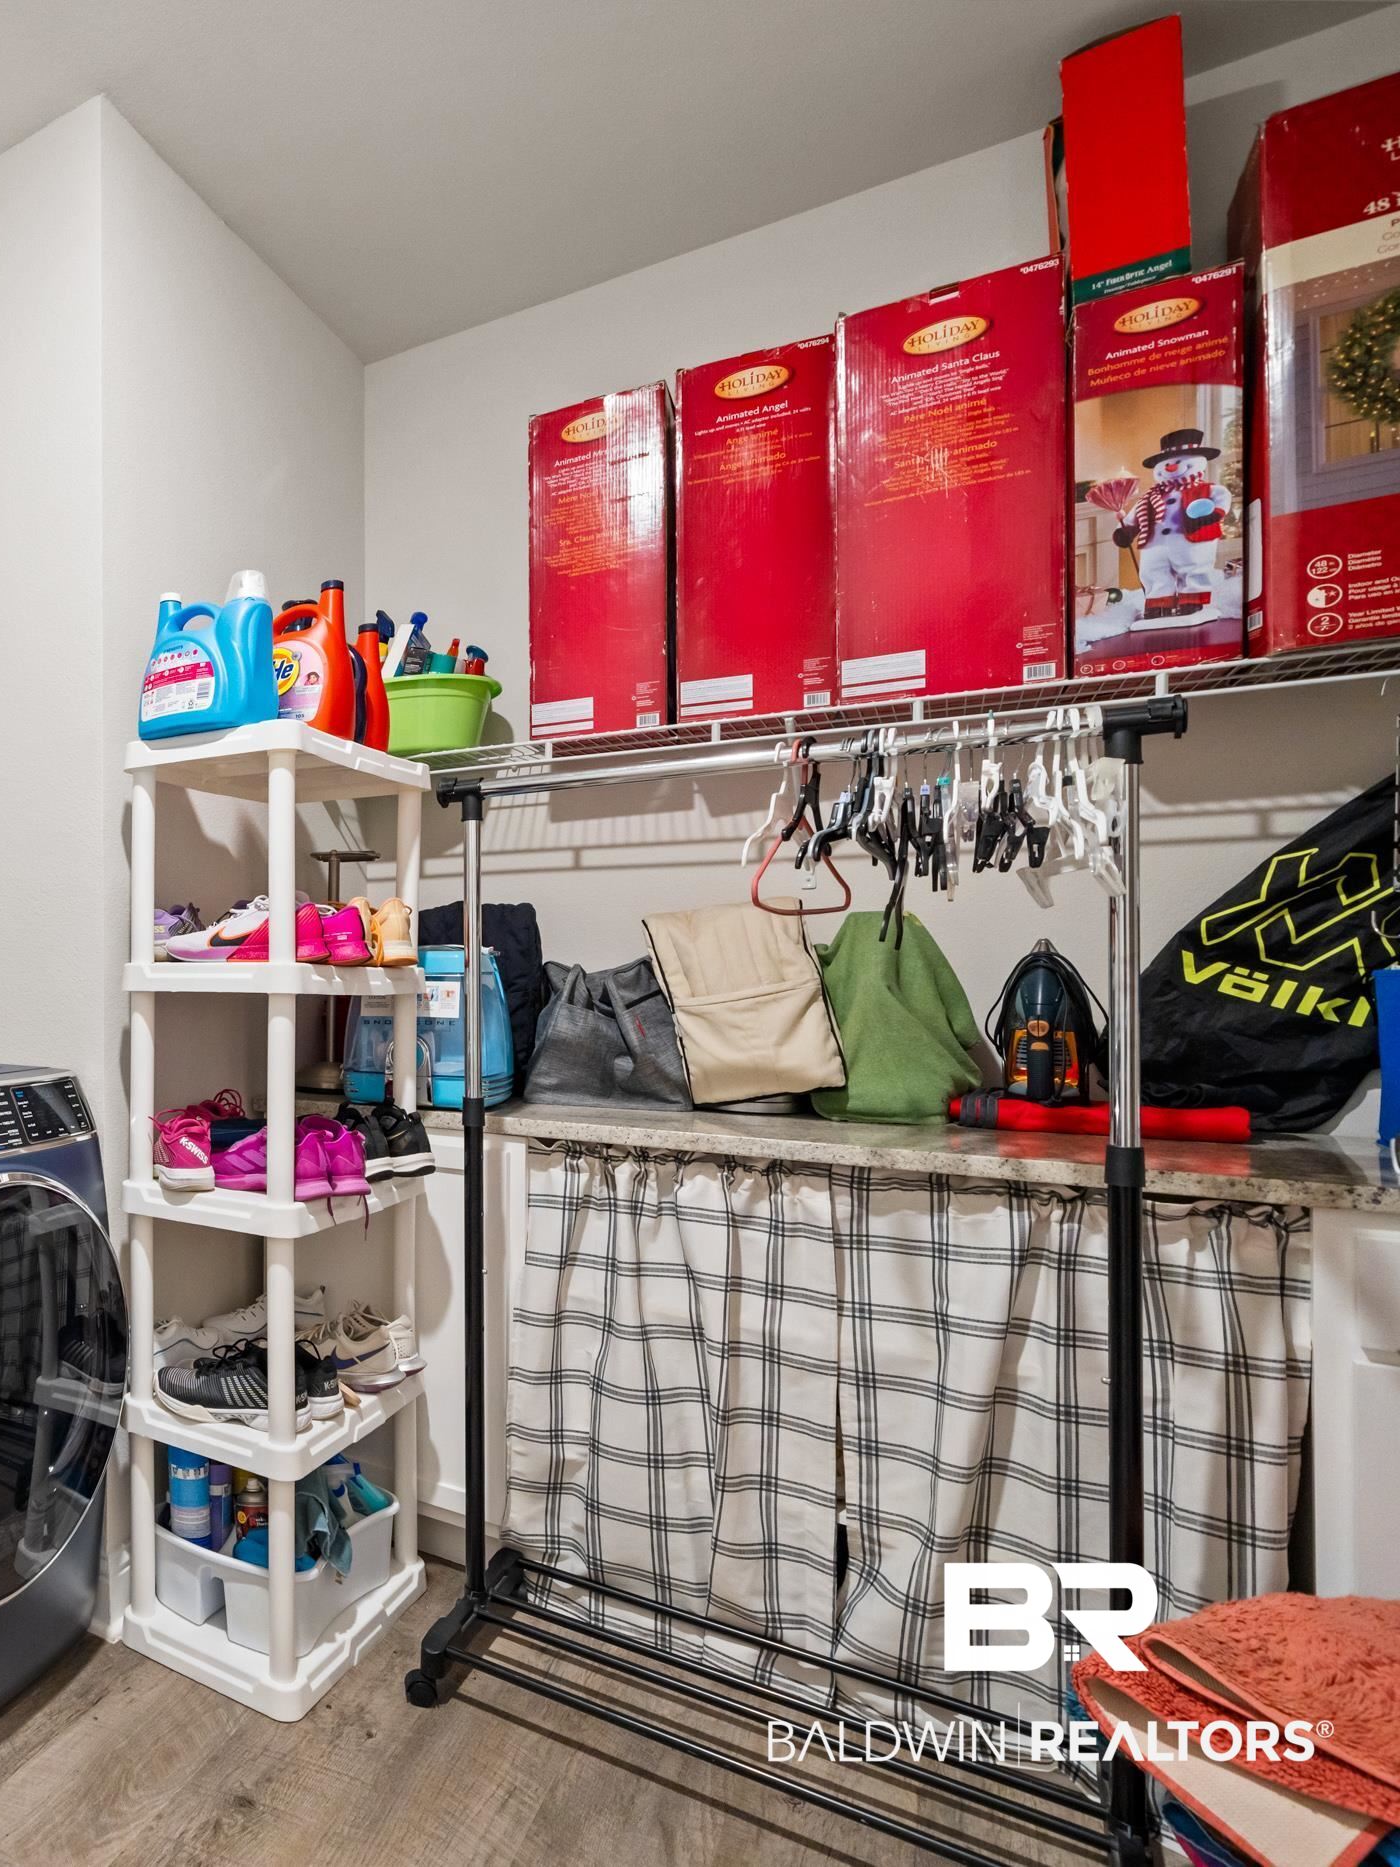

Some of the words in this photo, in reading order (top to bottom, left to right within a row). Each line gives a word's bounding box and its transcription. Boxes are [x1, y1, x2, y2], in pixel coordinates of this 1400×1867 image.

[1363, 197, 1391, 215] 48
[1088, 357, 1146, 376] Bonhomme
[1148, 352, 1162, 361] de
[1164, 345, 1193, 357] neige
[1196, 336, 1229, 350] animé
[1105, 341, 1155, 360] Animated
[1157, 330, 1209, 348] Snowman
[891, 364, 939, 384] Animated
[941, 355, 969, 371] Santa
[972, 351, 1000, 363] Claus
[1090, 372, 1132, 387] Muñeco
[1133, 368, 1147, 376] de
[1150, 361, 1177, 371] nieve
[1180, 350, 1226, 365] animado
[716, 406, 759, 423] Animated
[762, 400, 788, 414] Angel
[904, 413, 926, 424] Père
[554, 451, 591, 467] Animated
[953, 440, 997, 456] animado
[1321, 616, 1330, 625] 2
[179, 1136, 208, 1164] K-SWISS
